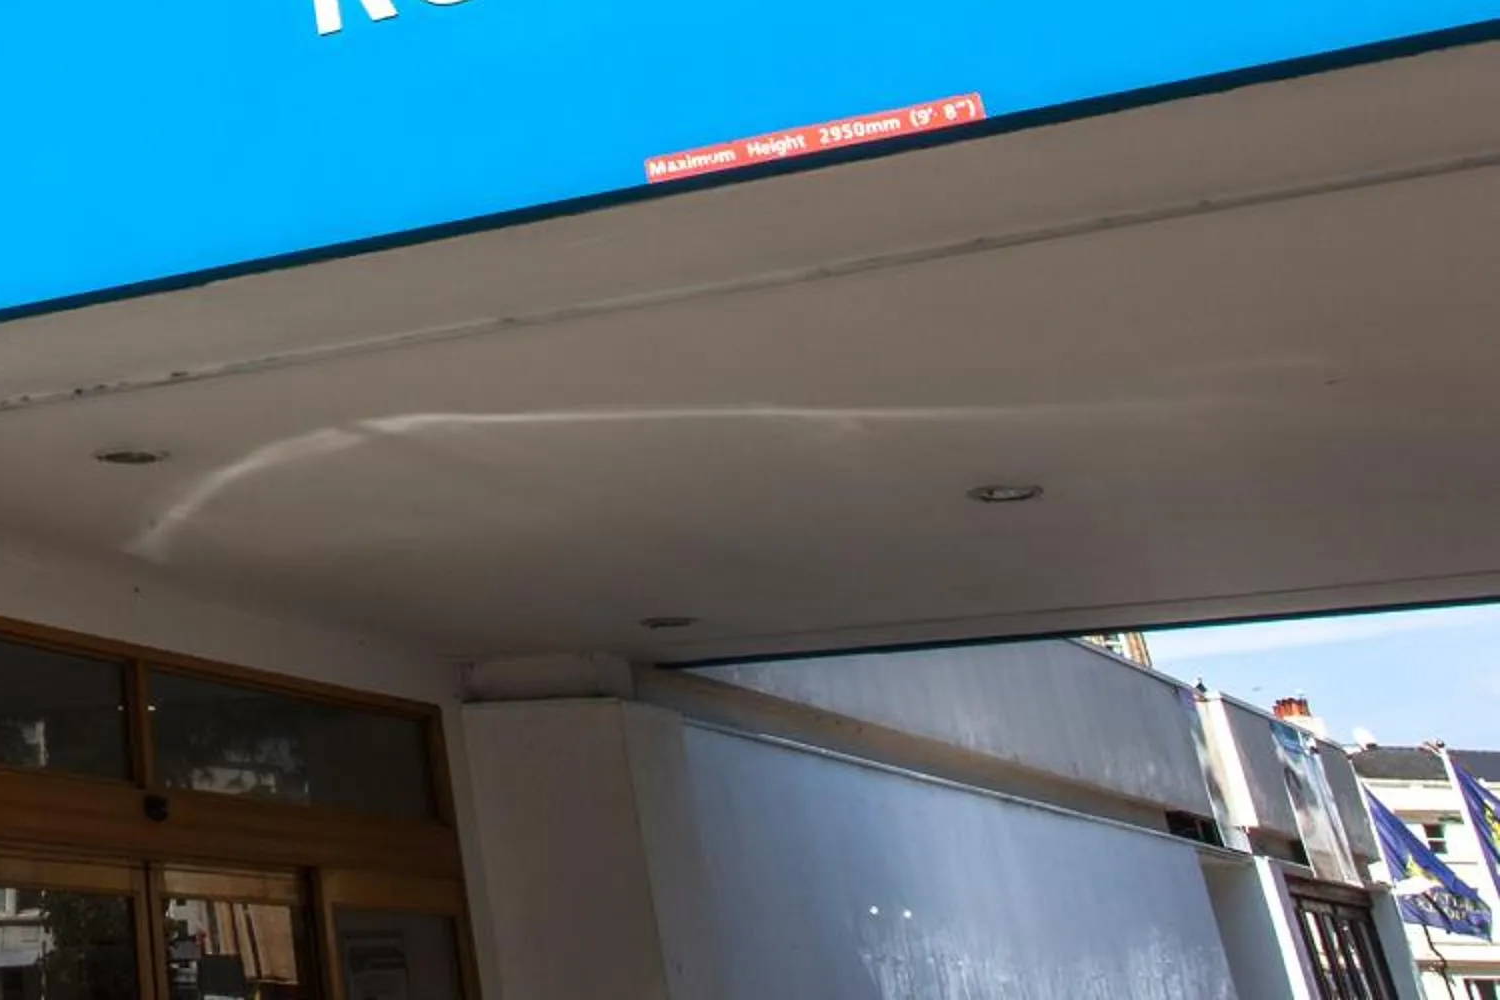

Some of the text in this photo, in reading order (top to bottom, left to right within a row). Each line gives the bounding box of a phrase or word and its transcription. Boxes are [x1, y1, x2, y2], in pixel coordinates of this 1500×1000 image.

[649, 149, 736, 177] Maximum
[746, 135, 806, 157] Height
[818, 117, 901, 145] 2950mm
